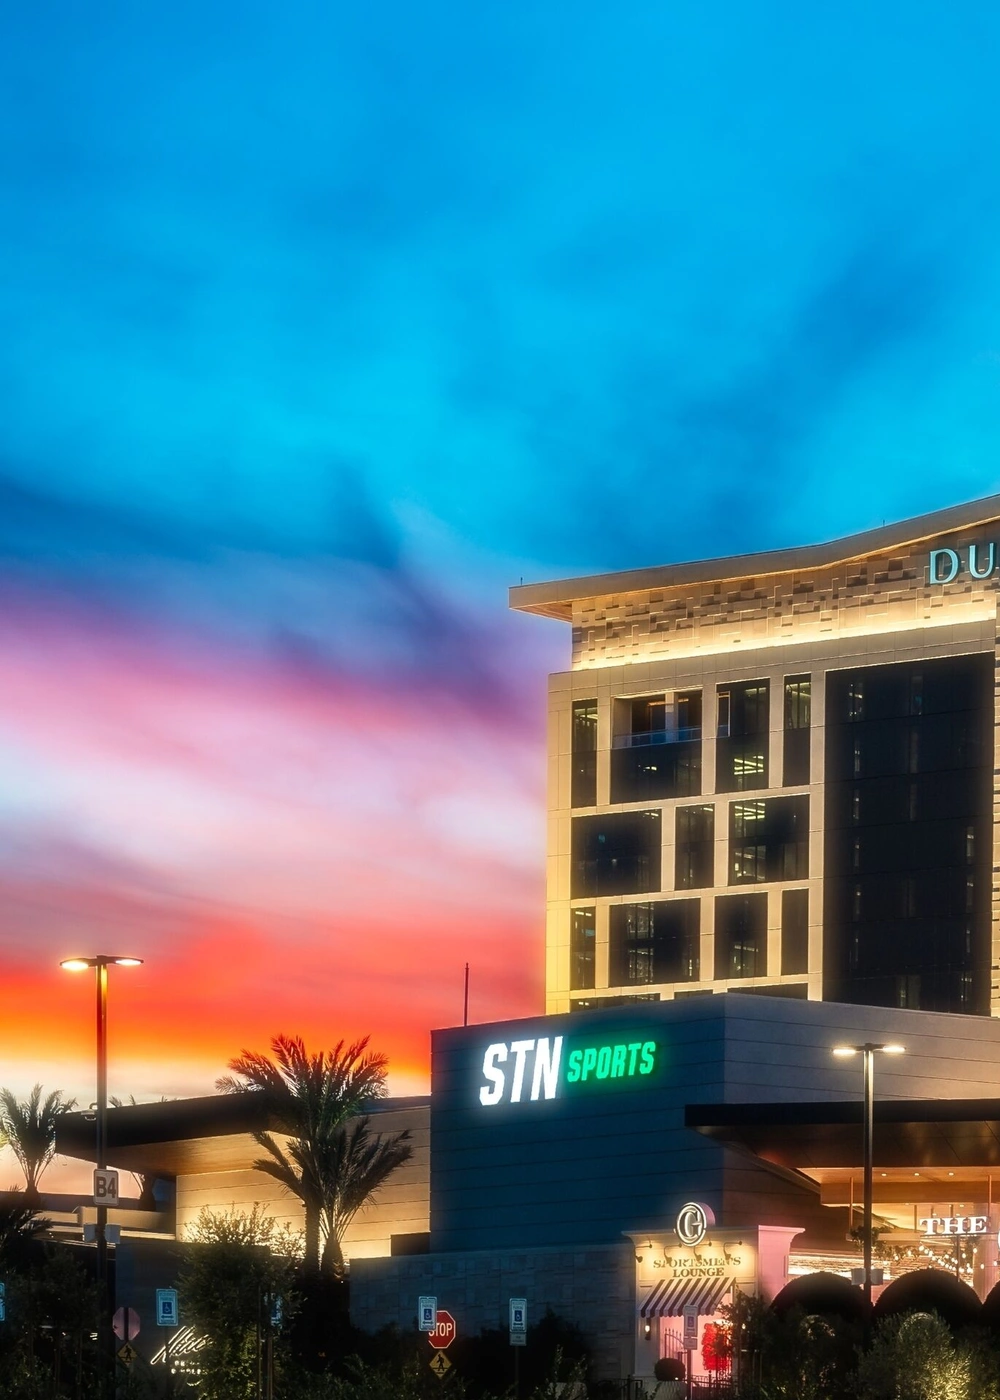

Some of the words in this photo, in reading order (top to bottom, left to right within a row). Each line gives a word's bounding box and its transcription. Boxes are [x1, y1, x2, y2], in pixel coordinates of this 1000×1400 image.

[479, 1036, 563, 1106] STN
[567, 1041, 656, 1083] SPORTS
[96, 1176, 117, 1198] B4
[919, 1216, 987, 1235] THE
[672, 1267, 725, 1278] LOUNGE
